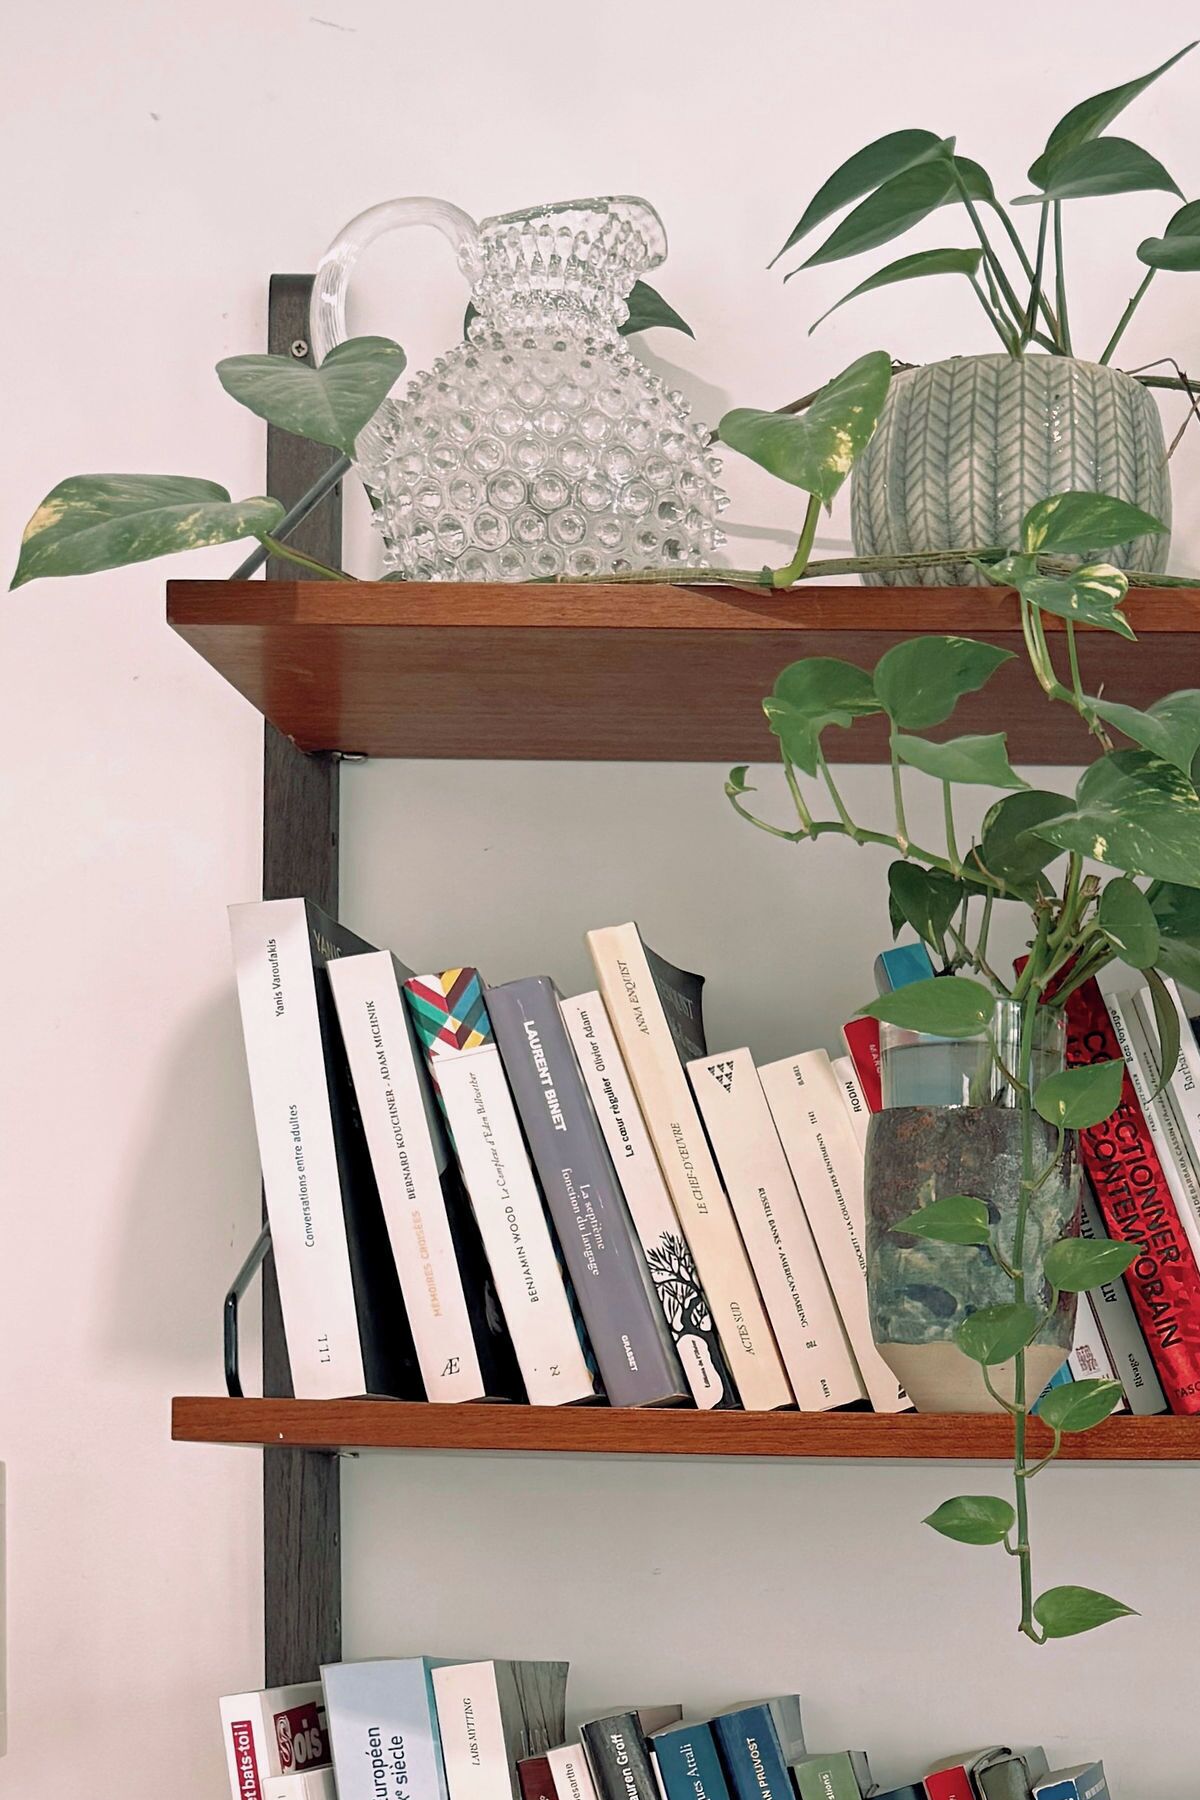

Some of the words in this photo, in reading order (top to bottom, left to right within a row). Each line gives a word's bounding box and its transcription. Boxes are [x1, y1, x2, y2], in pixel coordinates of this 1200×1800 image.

[266, 938, 281, 989] Varoufakis
[273, 991, 284, 1017] Yanis
[522, 1019, 553, 1088] LAURENT
[543, 1087, 567, 1133] BINET
[288, 1104, 301, 1142] adultes
[294, 1145, 305, 1172] entre
[298, 1174, 314, 1247] Conversations
[233, 1728, 256, 1790] bats-toi
[387, 1735, 408, 1784] siècle
[610, 1733, 628, 1767] Groff
[746, 1737, 768, 1788] PRUVOST
